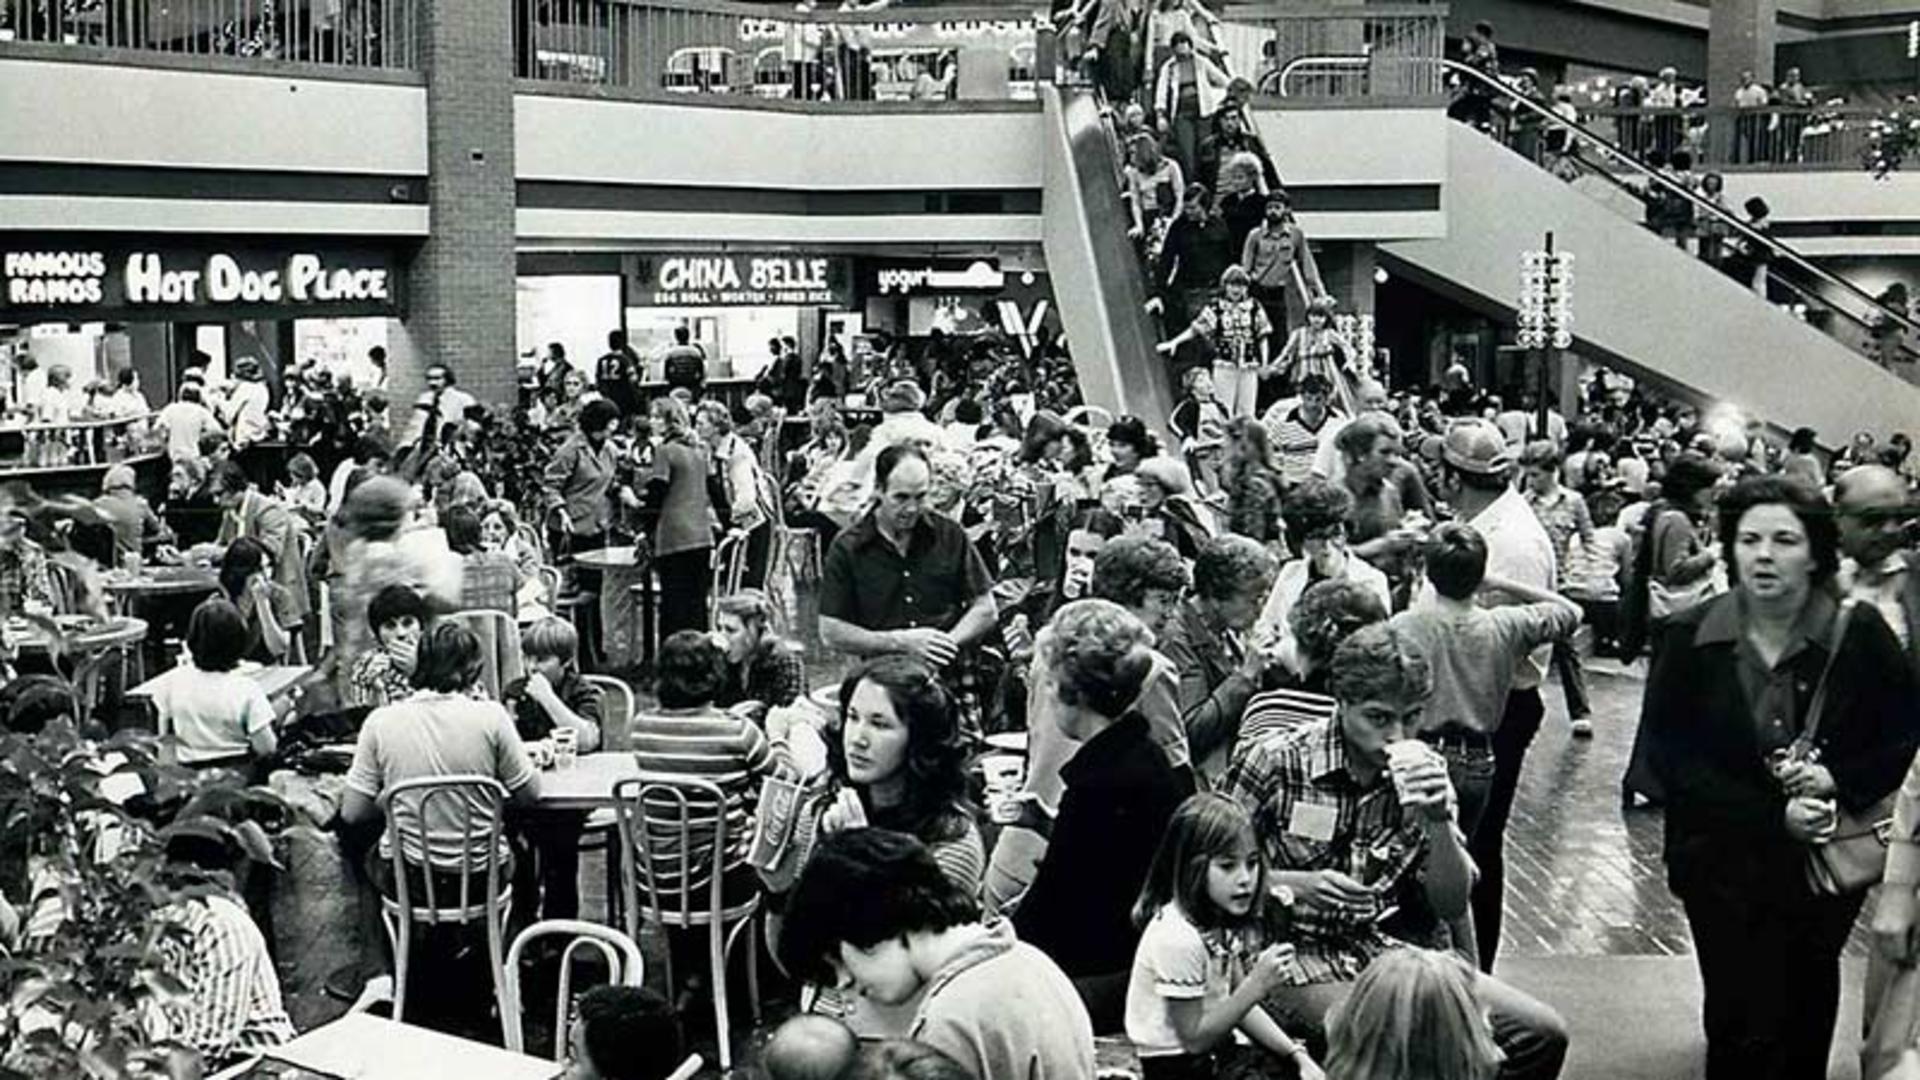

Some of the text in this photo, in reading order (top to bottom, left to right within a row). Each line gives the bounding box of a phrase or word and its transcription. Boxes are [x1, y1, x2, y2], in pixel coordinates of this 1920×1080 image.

[5, 252, 106, 277] FAMOUS
[660, 257, 828, 291] CHINA BELLE
[10, 278, 102, 303] RAMOS
[877, 266, 933, 294] yogurt
[601, 358, 621, 380] 12
